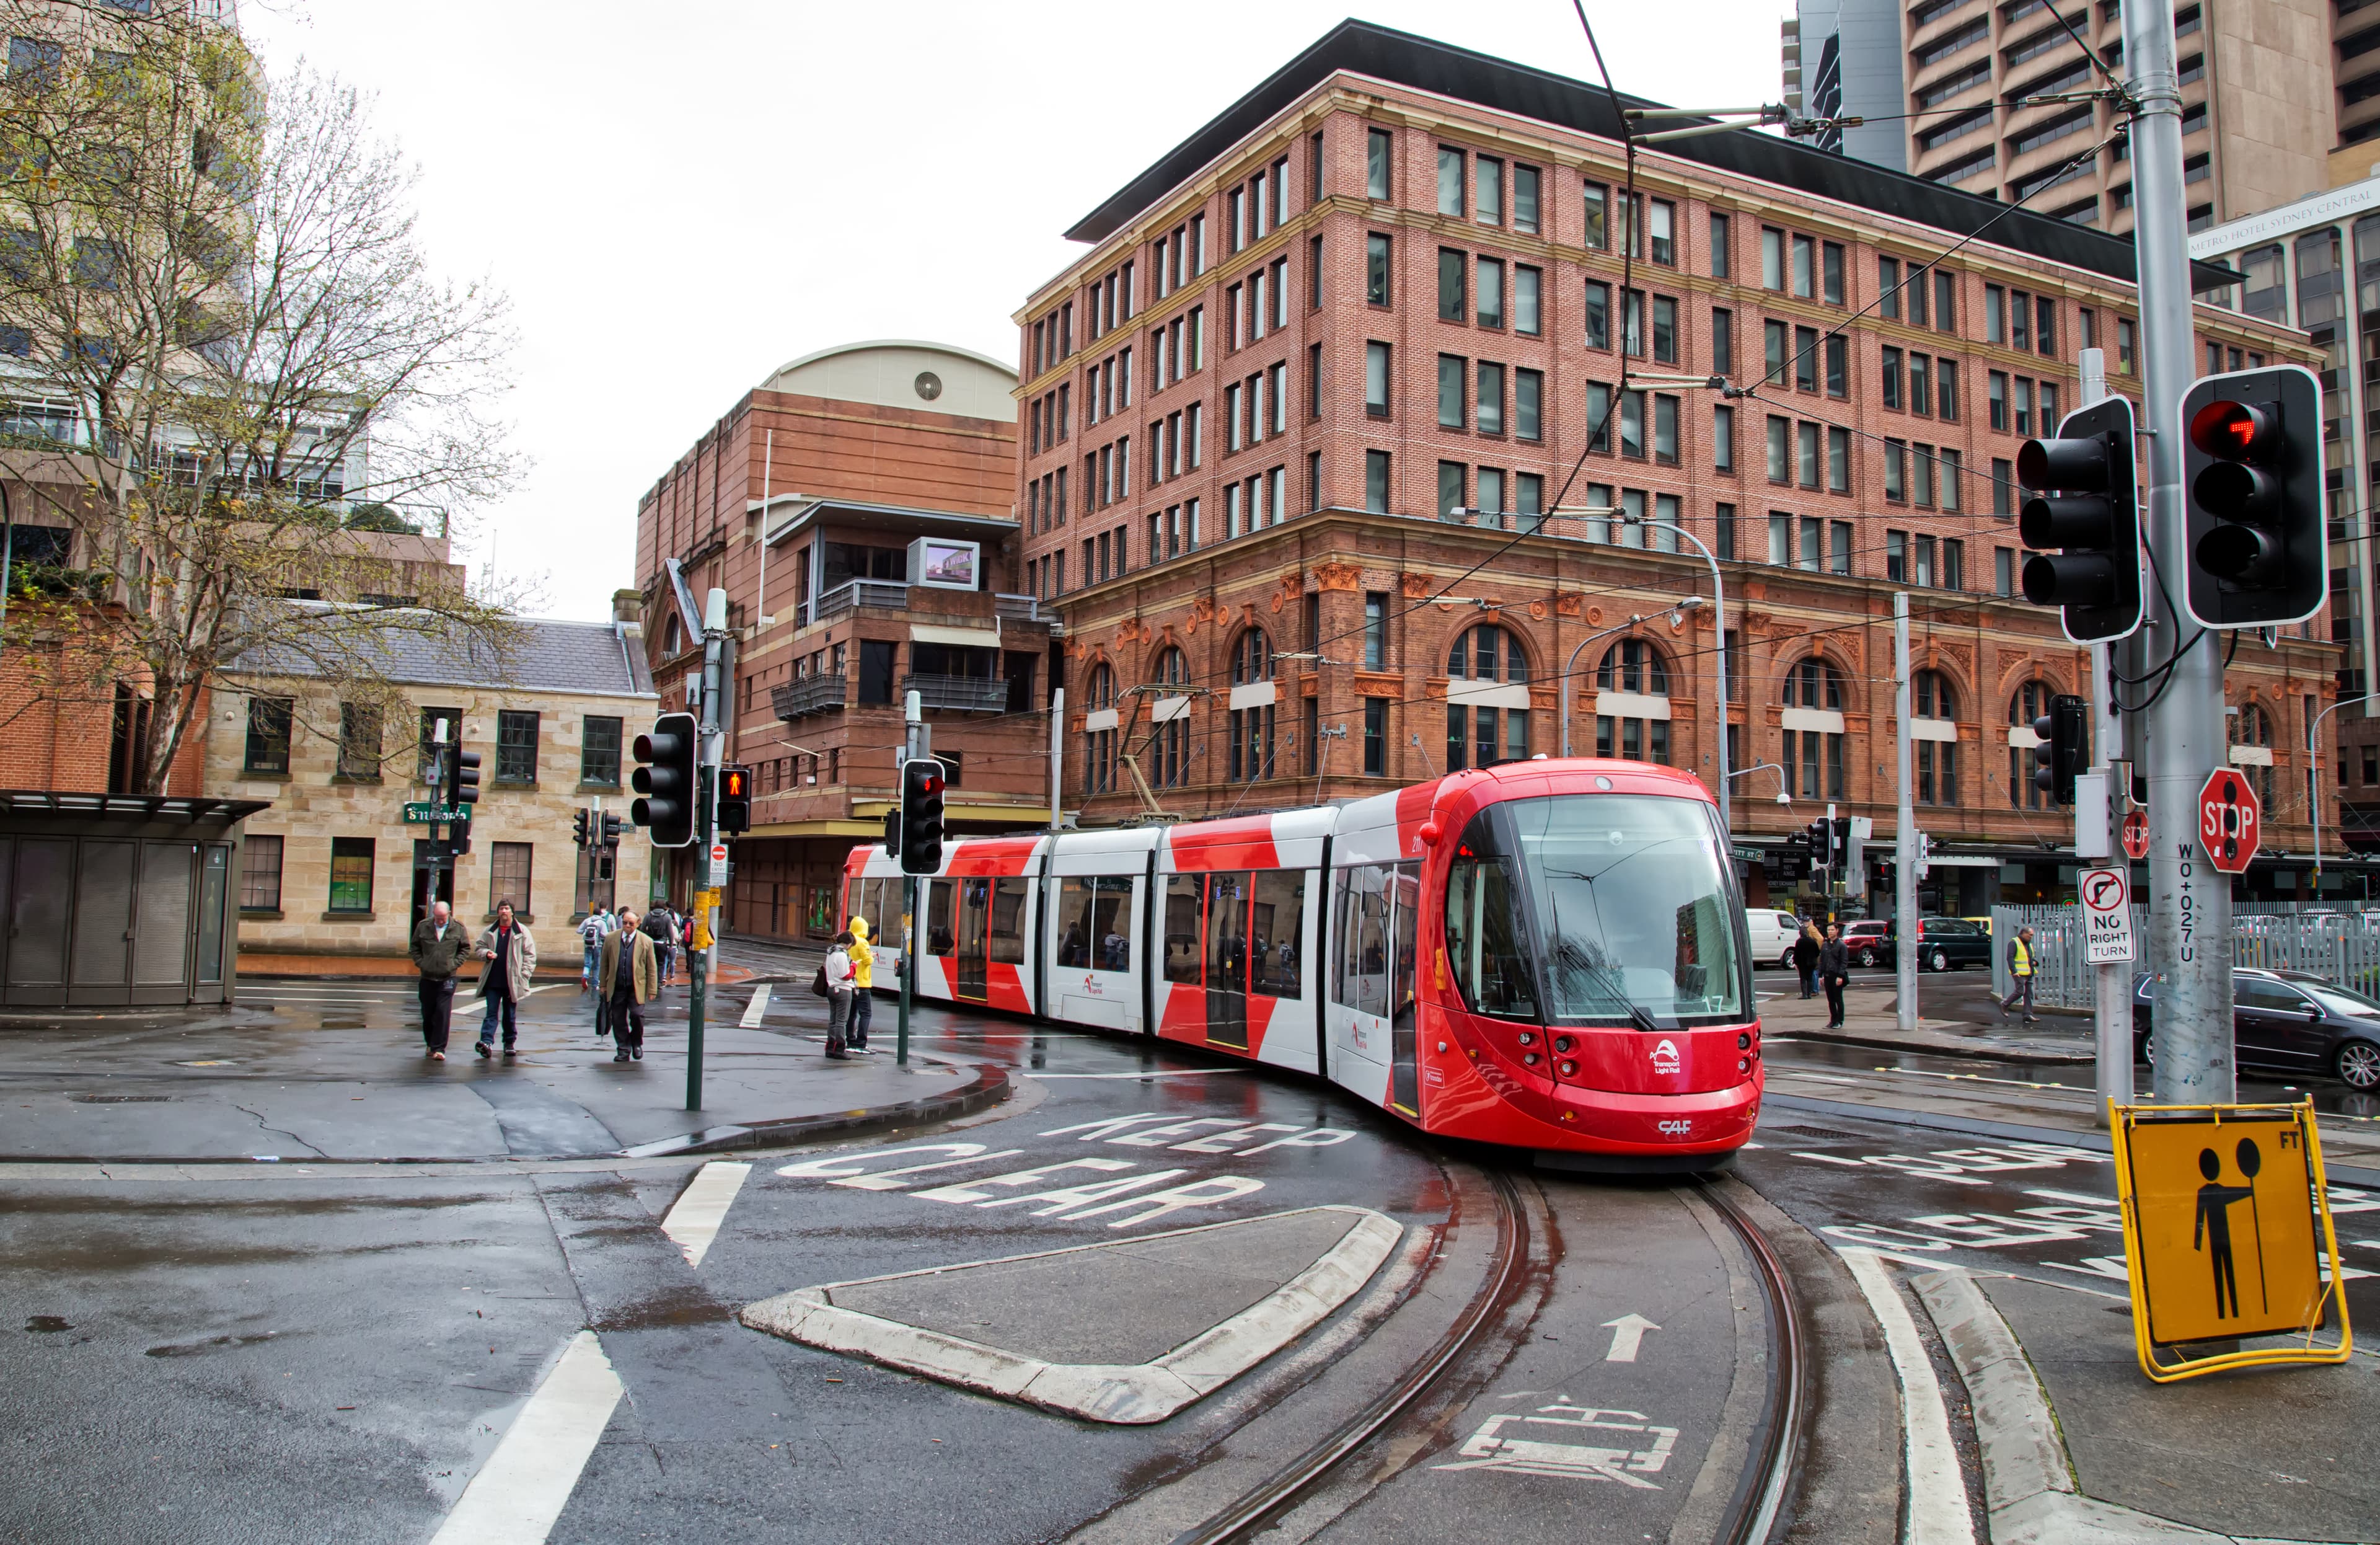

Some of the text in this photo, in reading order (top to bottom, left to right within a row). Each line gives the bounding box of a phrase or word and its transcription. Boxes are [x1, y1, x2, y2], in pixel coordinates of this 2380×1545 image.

[2190, 190, 2371, 253] METRO HOTEL SYDNEY CENTRAL
[2205, 801, 2253, 839] STOP
[2124, 826, 2148, 843] STOP
[2094, 914, 2120, 929] NO
[2090, 932, 2127, 944] RIGHT
[2093, 947, 2127, 956] TURN
[1036, 1113, 1357, 1156] KEEP
[1658, 1120, 1691, 1135] CAF
[2280, 1131, 2299, 1149] FT
[775, 1143, 1266, 1228] CLEAR
[1819, 1206, 2123, 1251] CLEAR
